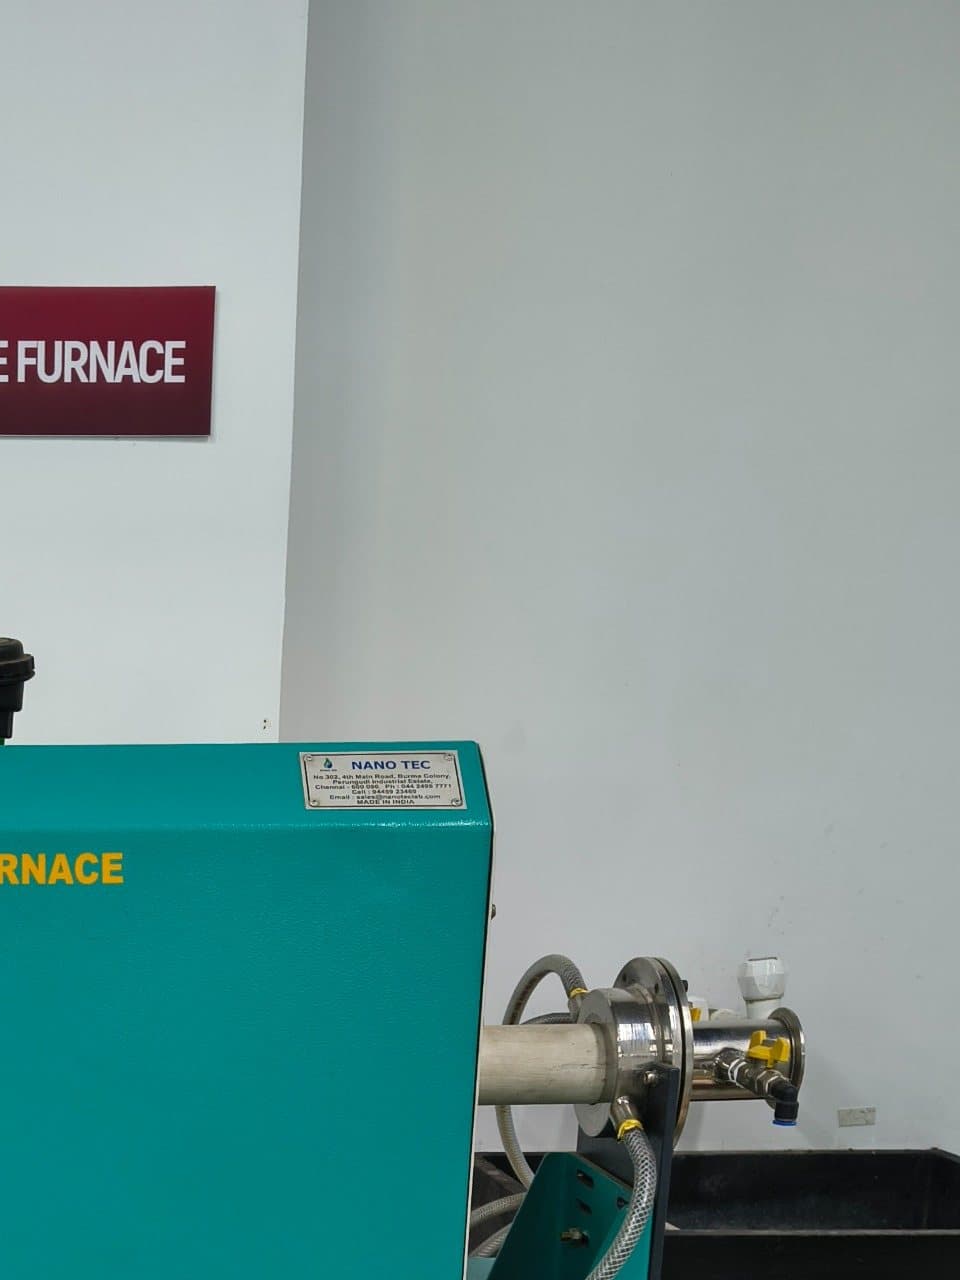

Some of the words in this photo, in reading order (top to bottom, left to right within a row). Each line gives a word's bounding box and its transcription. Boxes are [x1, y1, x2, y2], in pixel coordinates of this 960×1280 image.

[16, 339, 186, 384] FURNACE
[351, 760, 397, 770] NANO
[401, 760, 431, 770] TEC
